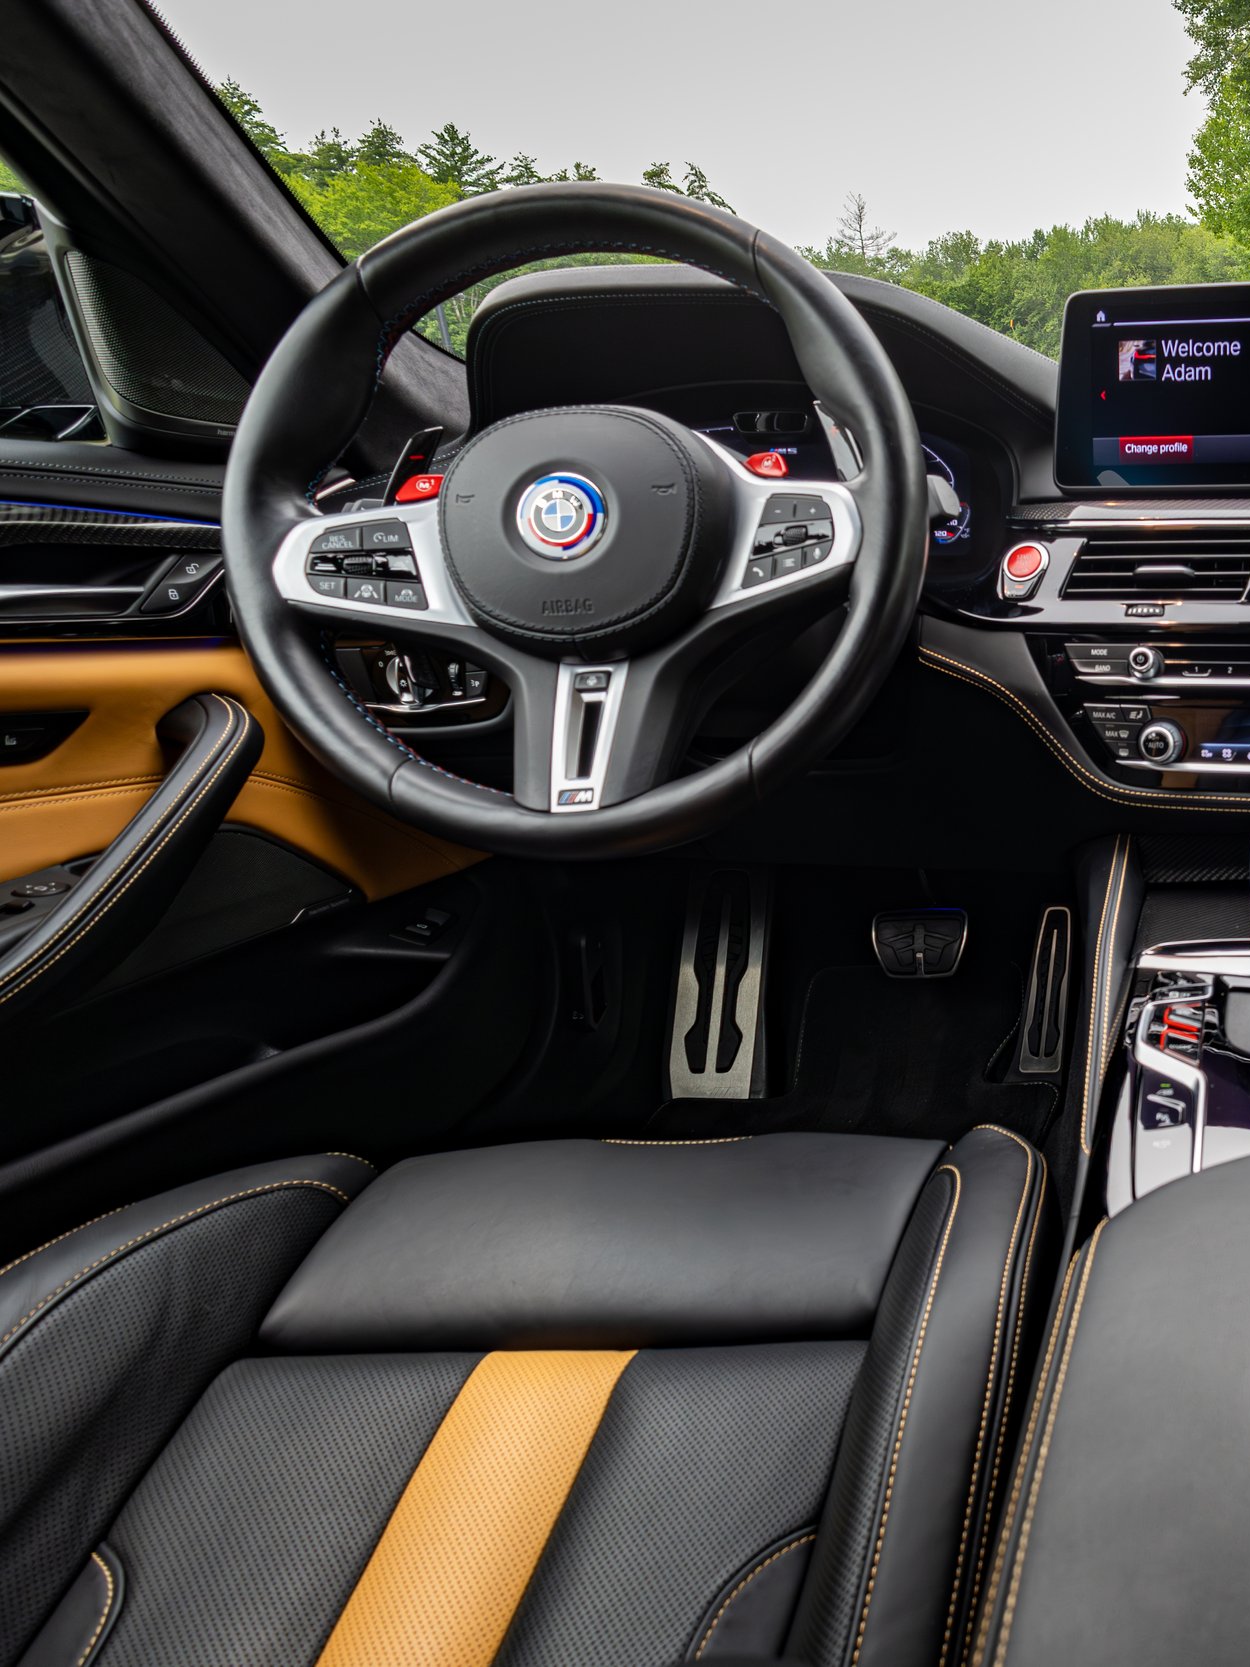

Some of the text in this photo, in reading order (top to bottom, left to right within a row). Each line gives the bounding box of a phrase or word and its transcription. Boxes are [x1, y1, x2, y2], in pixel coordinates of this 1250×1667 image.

[1161, 339, 1241, 358] Welcome
[1161, 363, 1212, 381] Adam
[1125, 442, 1188, 455] Change profile
[383, 534, 399, 543] LIM
[321, 541, 354, 550] CANCEL
[319, 582, 337, 591] SET
[394, 594, 418, 603] MODE
[541, 598, 594, 615] AIRBAG
[1090, 648, 1108, 656] MODE
[1105, 730, 1119, 738] MAX
[1147, 741, 1165, 749] AUTO
